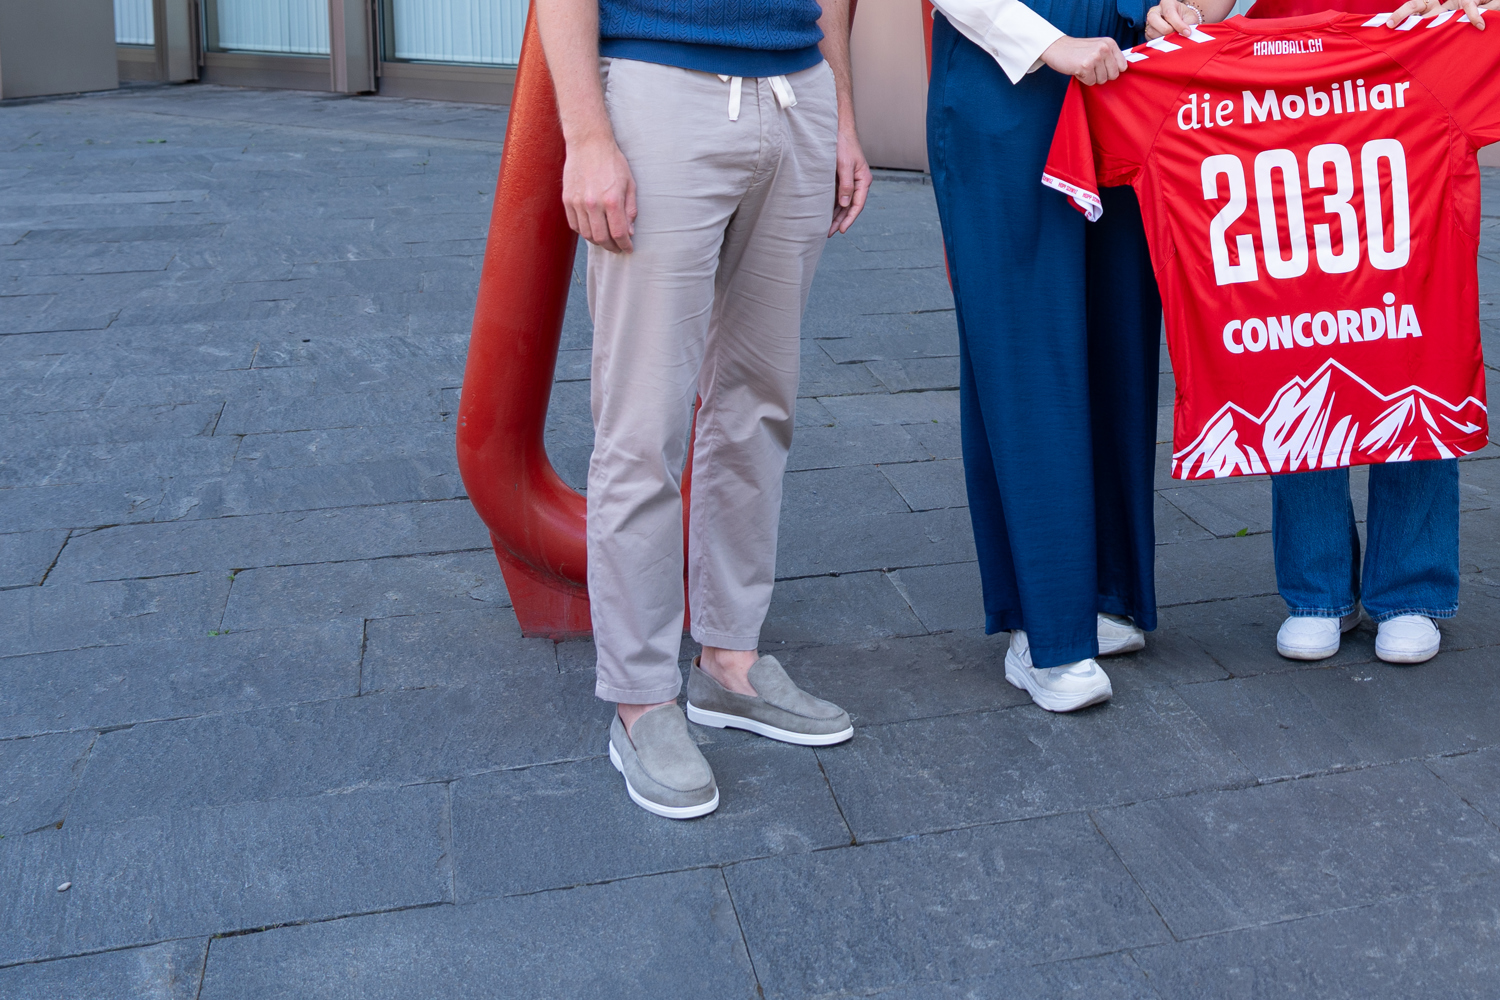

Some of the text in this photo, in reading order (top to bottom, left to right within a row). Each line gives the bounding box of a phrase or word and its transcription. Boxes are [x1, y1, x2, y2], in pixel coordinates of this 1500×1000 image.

[1253, 37, 1324, 56] HANDBALL.CH
[1176, 77, 1411, 131] die Mobiliar
[1200, 138, 1411, 286] 2030
